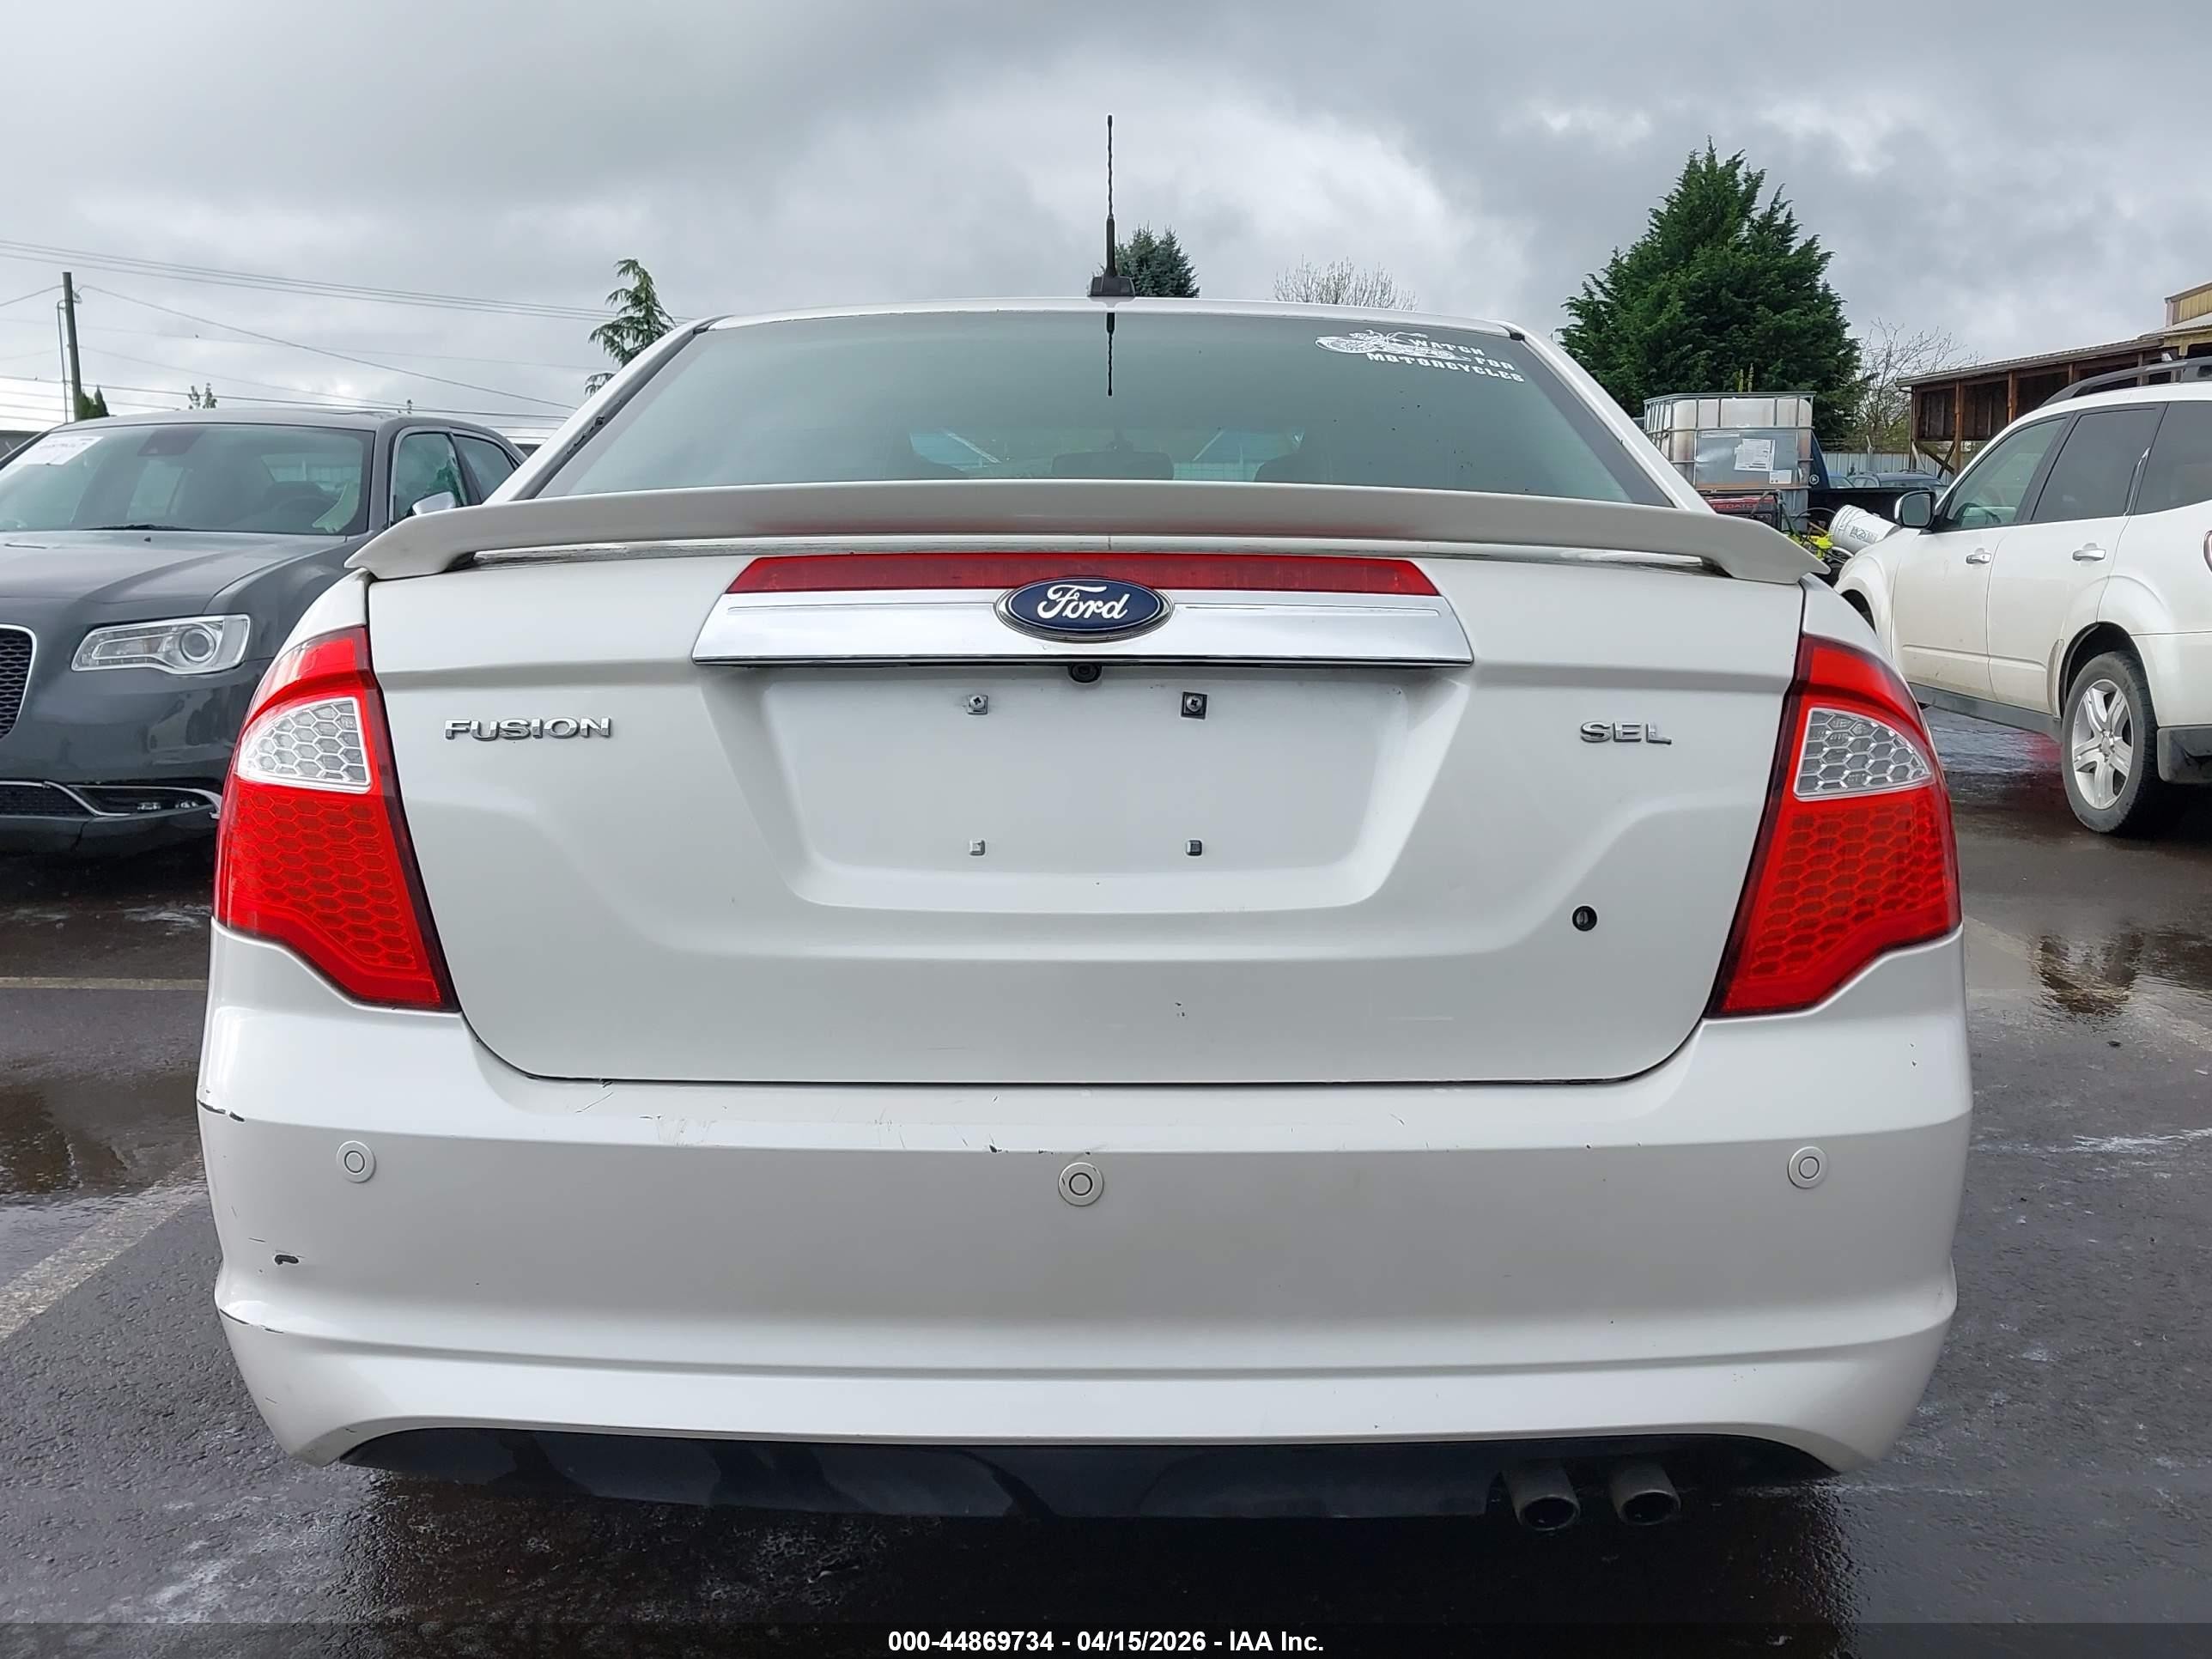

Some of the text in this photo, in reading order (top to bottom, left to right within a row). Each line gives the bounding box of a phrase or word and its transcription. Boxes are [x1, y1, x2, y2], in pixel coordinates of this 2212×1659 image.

[1408, 338, 1486, 356] WATCH
[1366, 352, 1525, 382] MOTORCYCLES
[1475, 356, 1516, 371] FOR
[1036, 584, 1131, 619] Ford
[445, 717, 612, 742] FUSION
[1580, 720, 1673, 745] SEL
